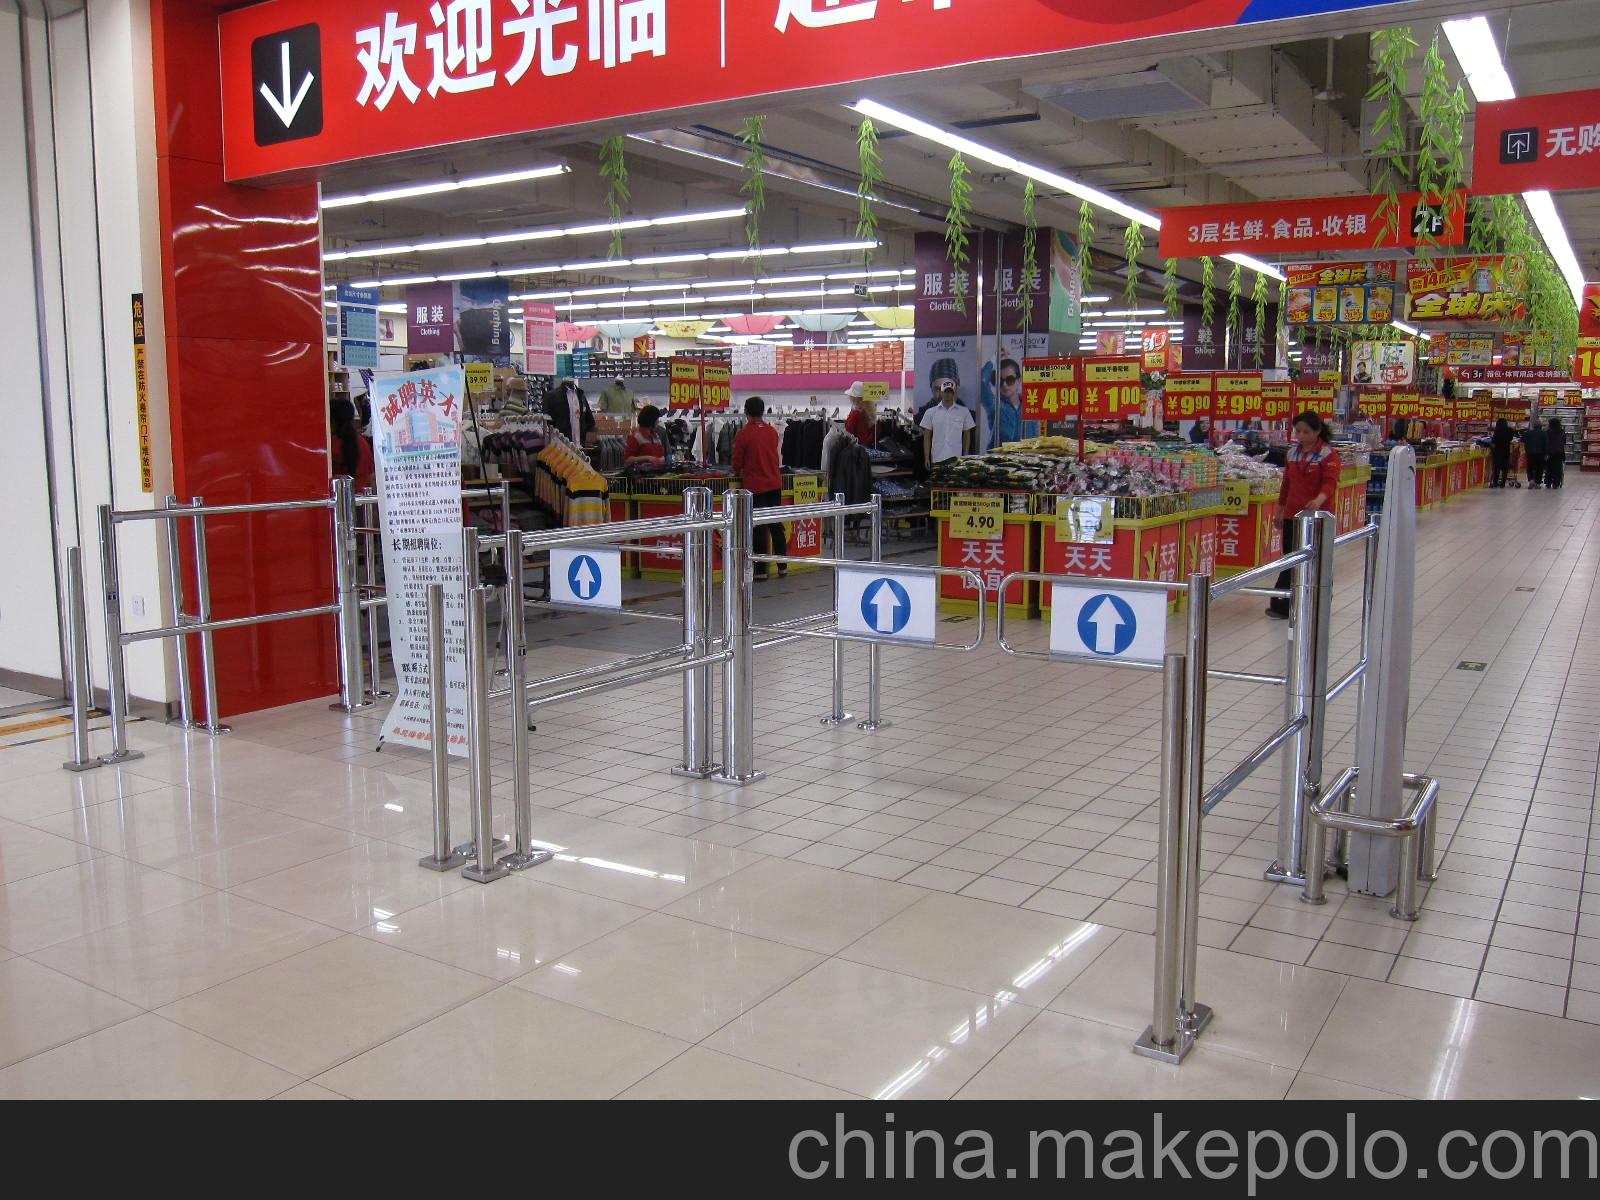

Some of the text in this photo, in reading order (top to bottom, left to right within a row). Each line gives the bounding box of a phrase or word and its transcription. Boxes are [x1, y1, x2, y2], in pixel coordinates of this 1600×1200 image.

[354, 0, 667, 112] 欢迎光临
[923, 271, 970, 296] 服装
[133, 300, 144, 338] 危险
[416, 304, 444, 324] 服装
[420, 327, 440, 337] Clothing
[926, 340, 960, 350] PLAYBOY
[469, 375, 488, 384] 39.90
[1472, 369, 1483, 379] 3F
[966, 515, 995, 529] 4.90
[796, 529, 817, 549] 便宜
[960, 541, 1006, 565] 天天
[1064, 546, 1113, 572] 天天
[1159, 542, 1177, 566] 天天
